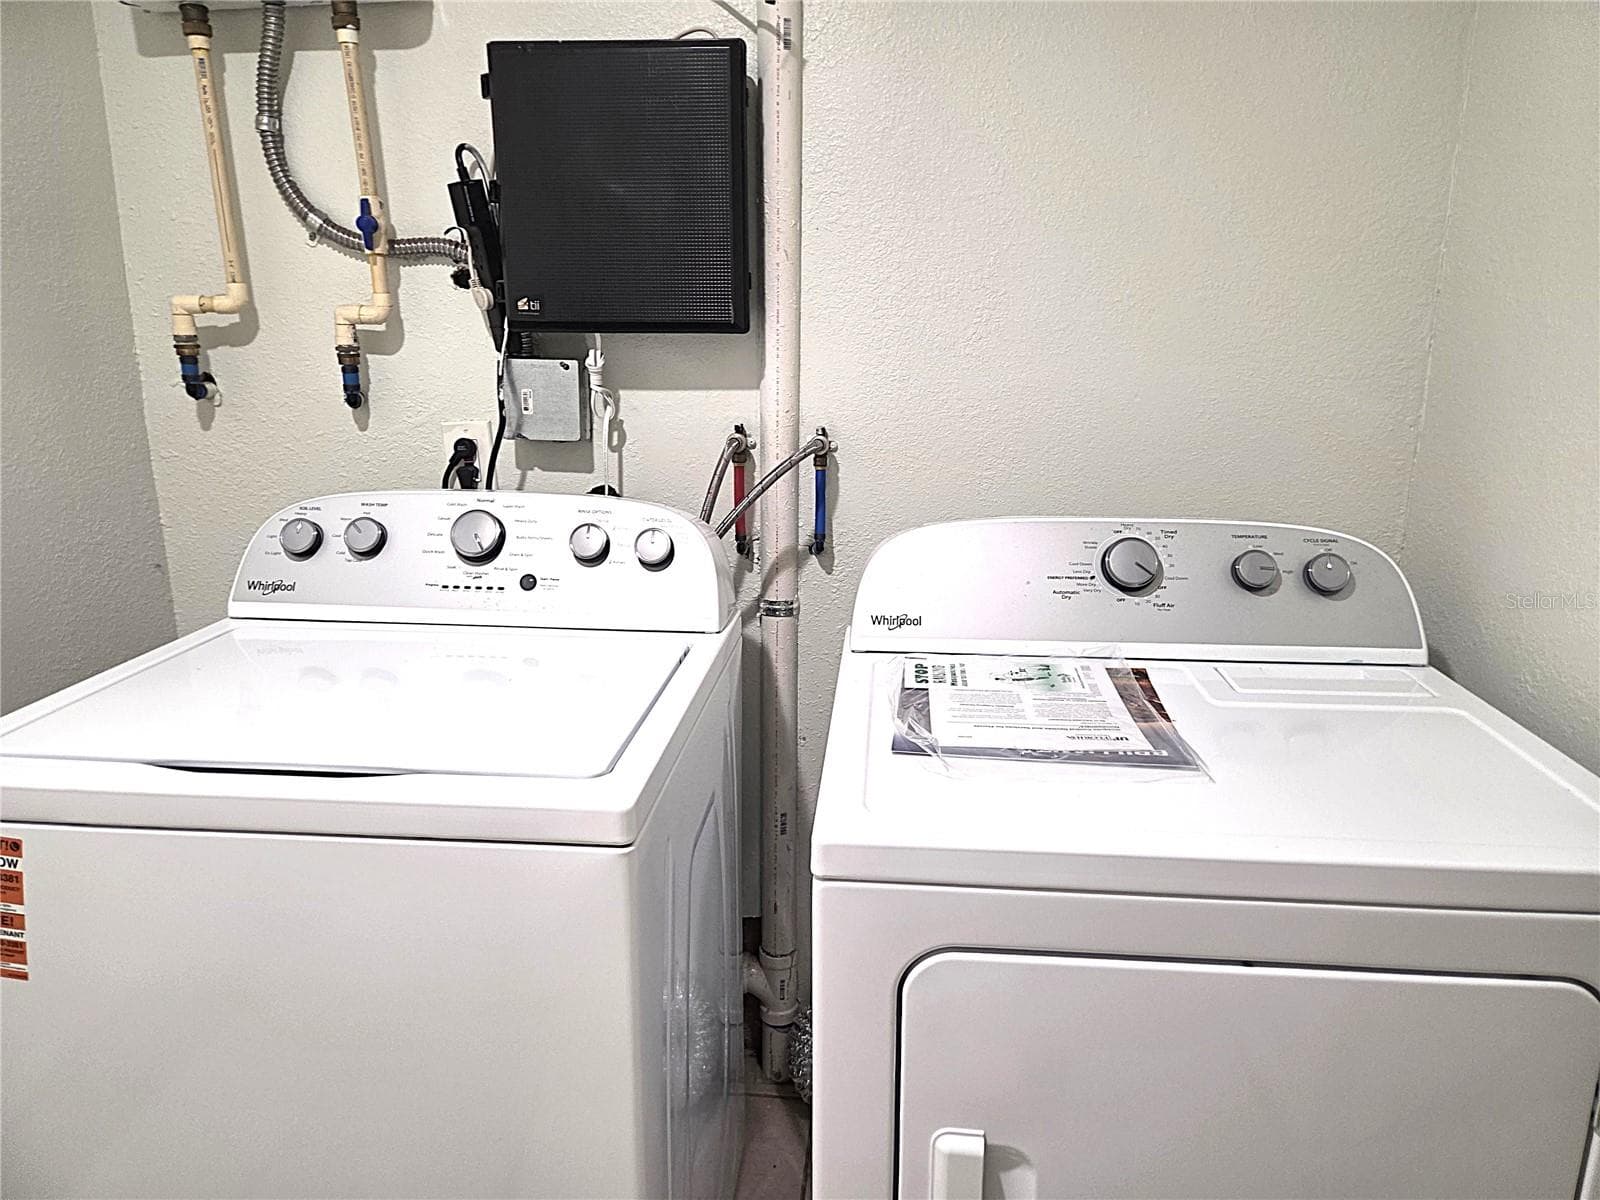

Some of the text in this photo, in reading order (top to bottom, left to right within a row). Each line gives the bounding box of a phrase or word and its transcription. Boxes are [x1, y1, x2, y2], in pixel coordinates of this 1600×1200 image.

[247, 579, 296, 596] Whirlpool
[870, 614, 922, 631] Whirlpool
[914, 664, 928, 684] STOP
